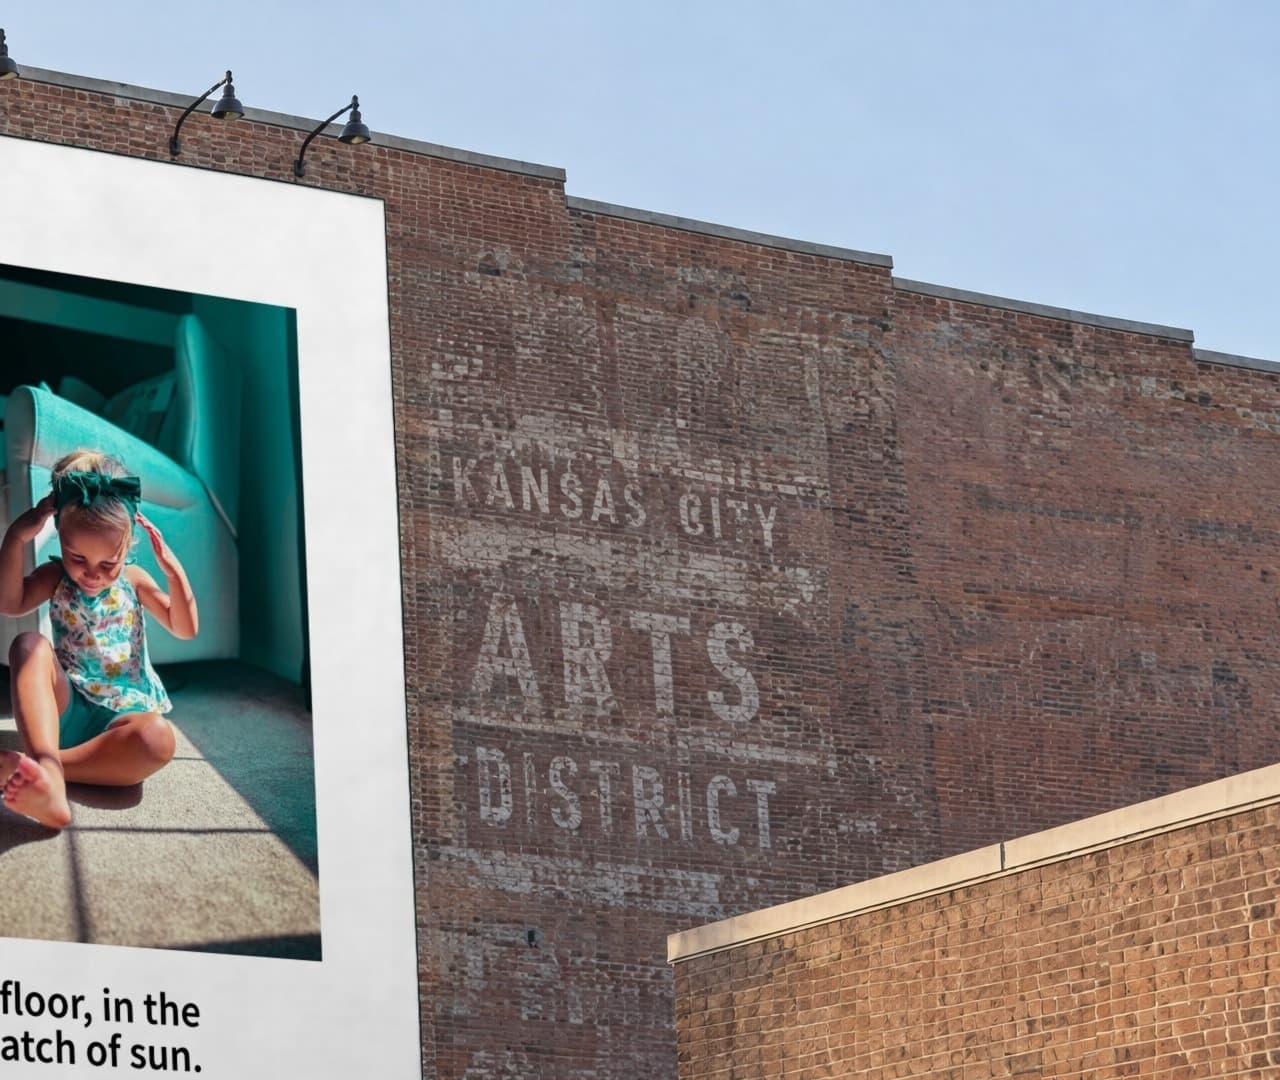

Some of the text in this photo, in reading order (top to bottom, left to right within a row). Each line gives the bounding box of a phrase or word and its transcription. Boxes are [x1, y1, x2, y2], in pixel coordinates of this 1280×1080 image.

[451, 455, 778, 549] KANSAS CITY
[471, 591, 761, 724] ARTS
[475, 745, 778, 851] DISTRICT
[0, 979, 93, 1028] floor,
[102, 987, 134, 1024] in
[143, 991, 201, 1028] the
[86, 1032, 122, 1068] of
[130, 1043, 202, 1073] sun.
